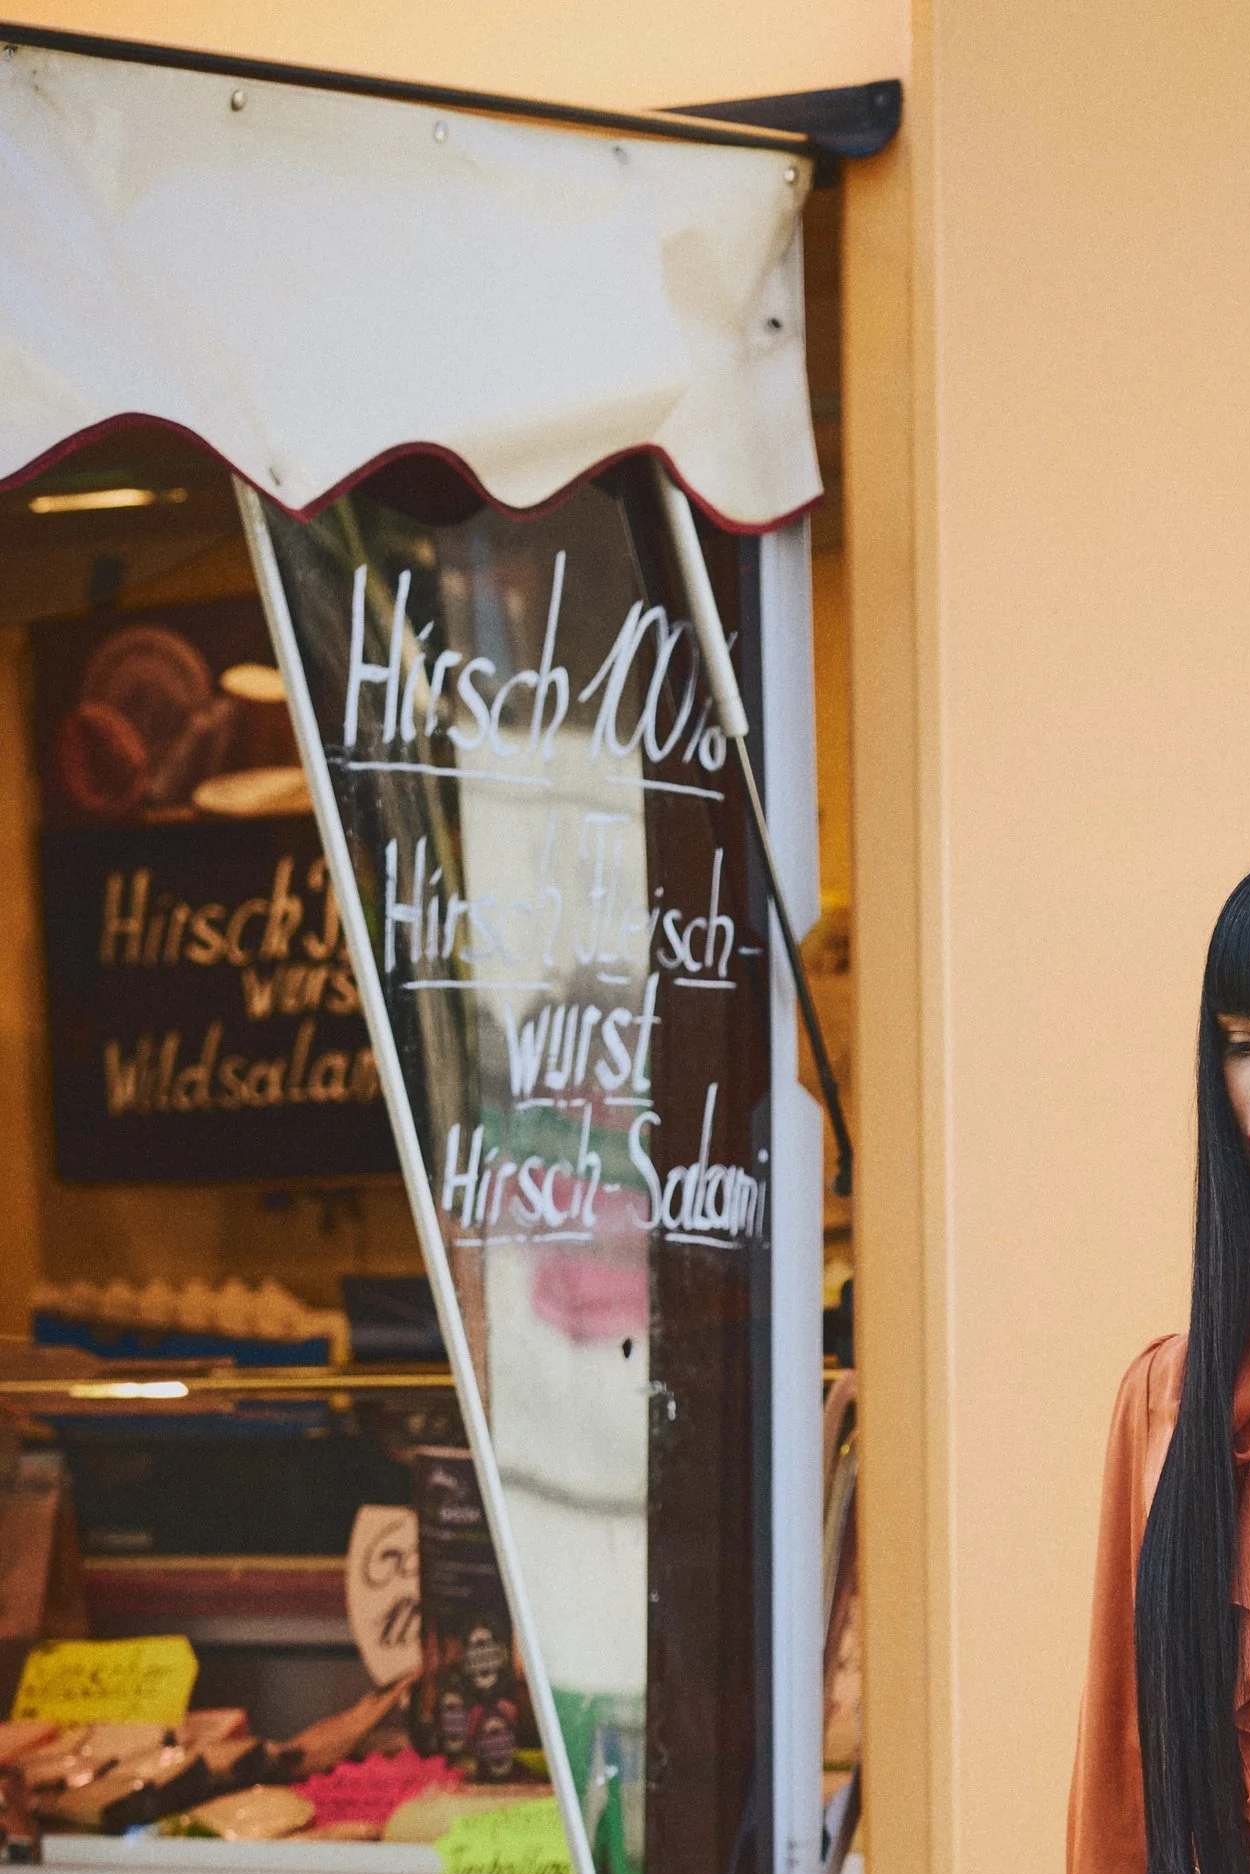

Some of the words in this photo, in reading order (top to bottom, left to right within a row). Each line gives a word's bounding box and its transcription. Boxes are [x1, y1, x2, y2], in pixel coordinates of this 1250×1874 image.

[343, 549, 572, 764] Hirsch
[577, 599, 738, 773] 100%
[101, 852, 304, 968] Hirsch
[384, 809, 563, 974] Hirsch
[240, 960, 370, 1022] wurs
